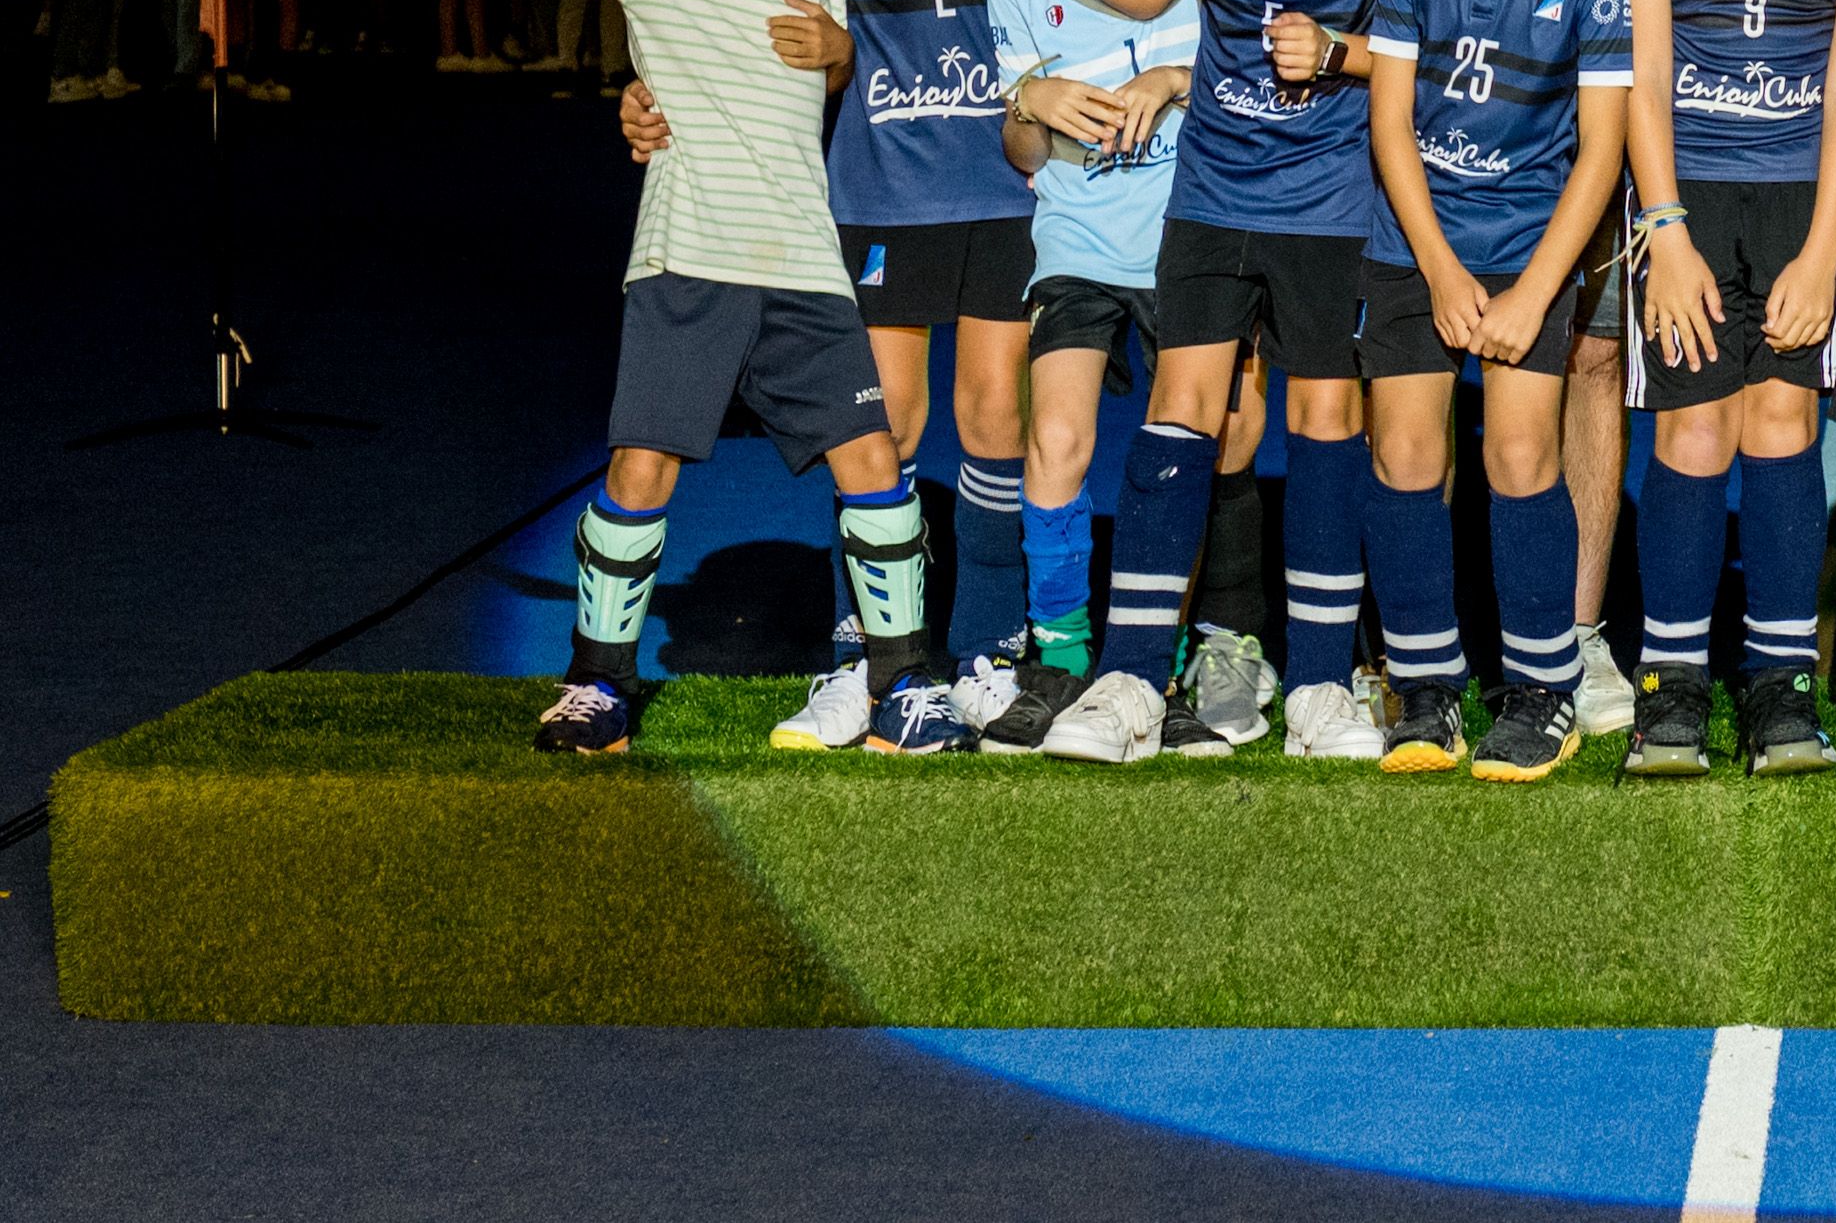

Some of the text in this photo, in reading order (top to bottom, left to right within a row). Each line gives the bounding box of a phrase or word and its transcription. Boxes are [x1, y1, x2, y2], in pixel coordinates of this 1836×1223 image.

[1443, 35, 1500, 103] 25
[1675, 62, 1823, 116] Enjoy Cuba
[867, 63, 1000, 120] Enjoy Cu
[1214, 77, 1270, 117] Enjoy
[1147, 134, 1177, 159] Cu
[1458, 143, 1511, 173] Cuba
[831, 631, 866, 645] adida
